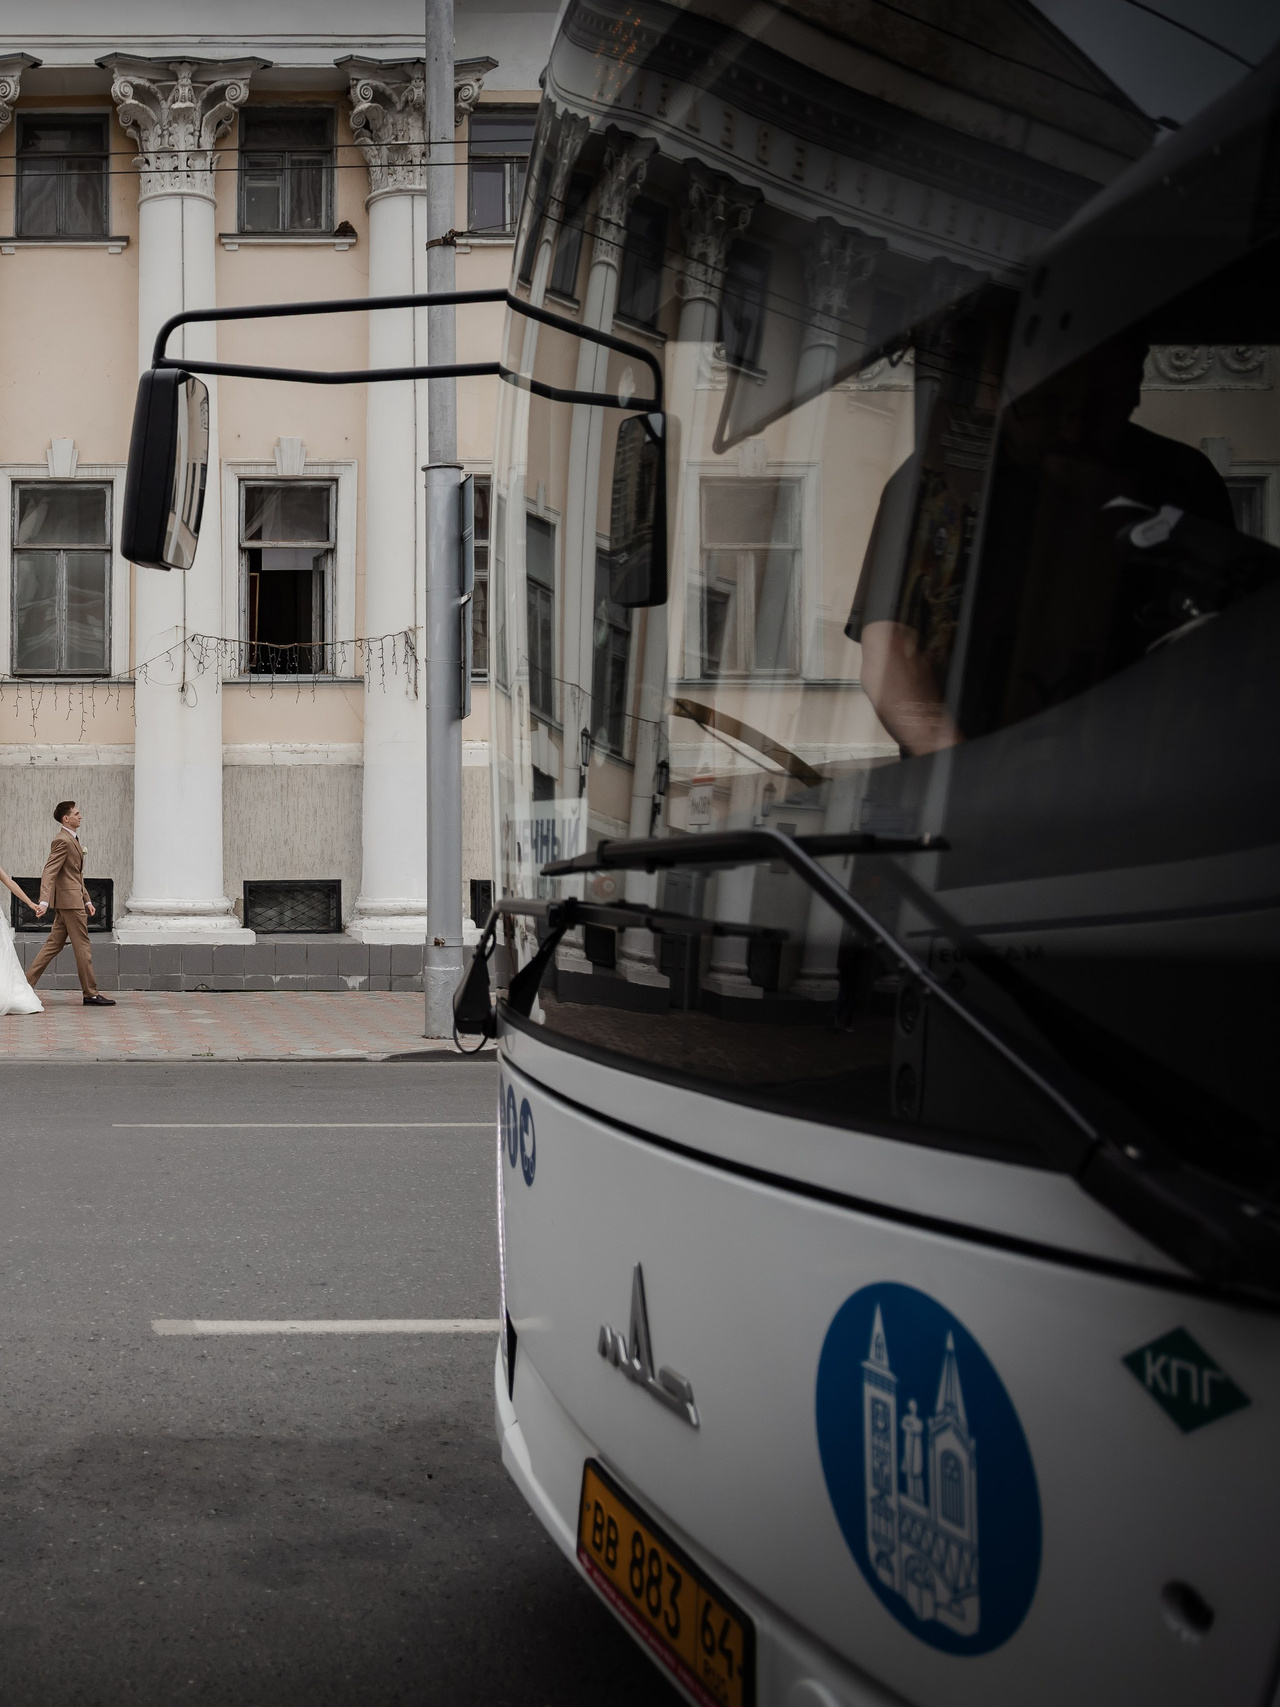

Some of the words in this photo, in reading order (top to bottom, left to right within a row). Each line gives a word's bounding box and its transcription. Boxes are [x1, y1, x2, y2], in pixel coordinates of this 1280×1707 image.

[1145, 1350, 1225, 1408] КПГ
[630, 1530, 682, 1640] 883
[701, 1600, 733, 1679] 64
